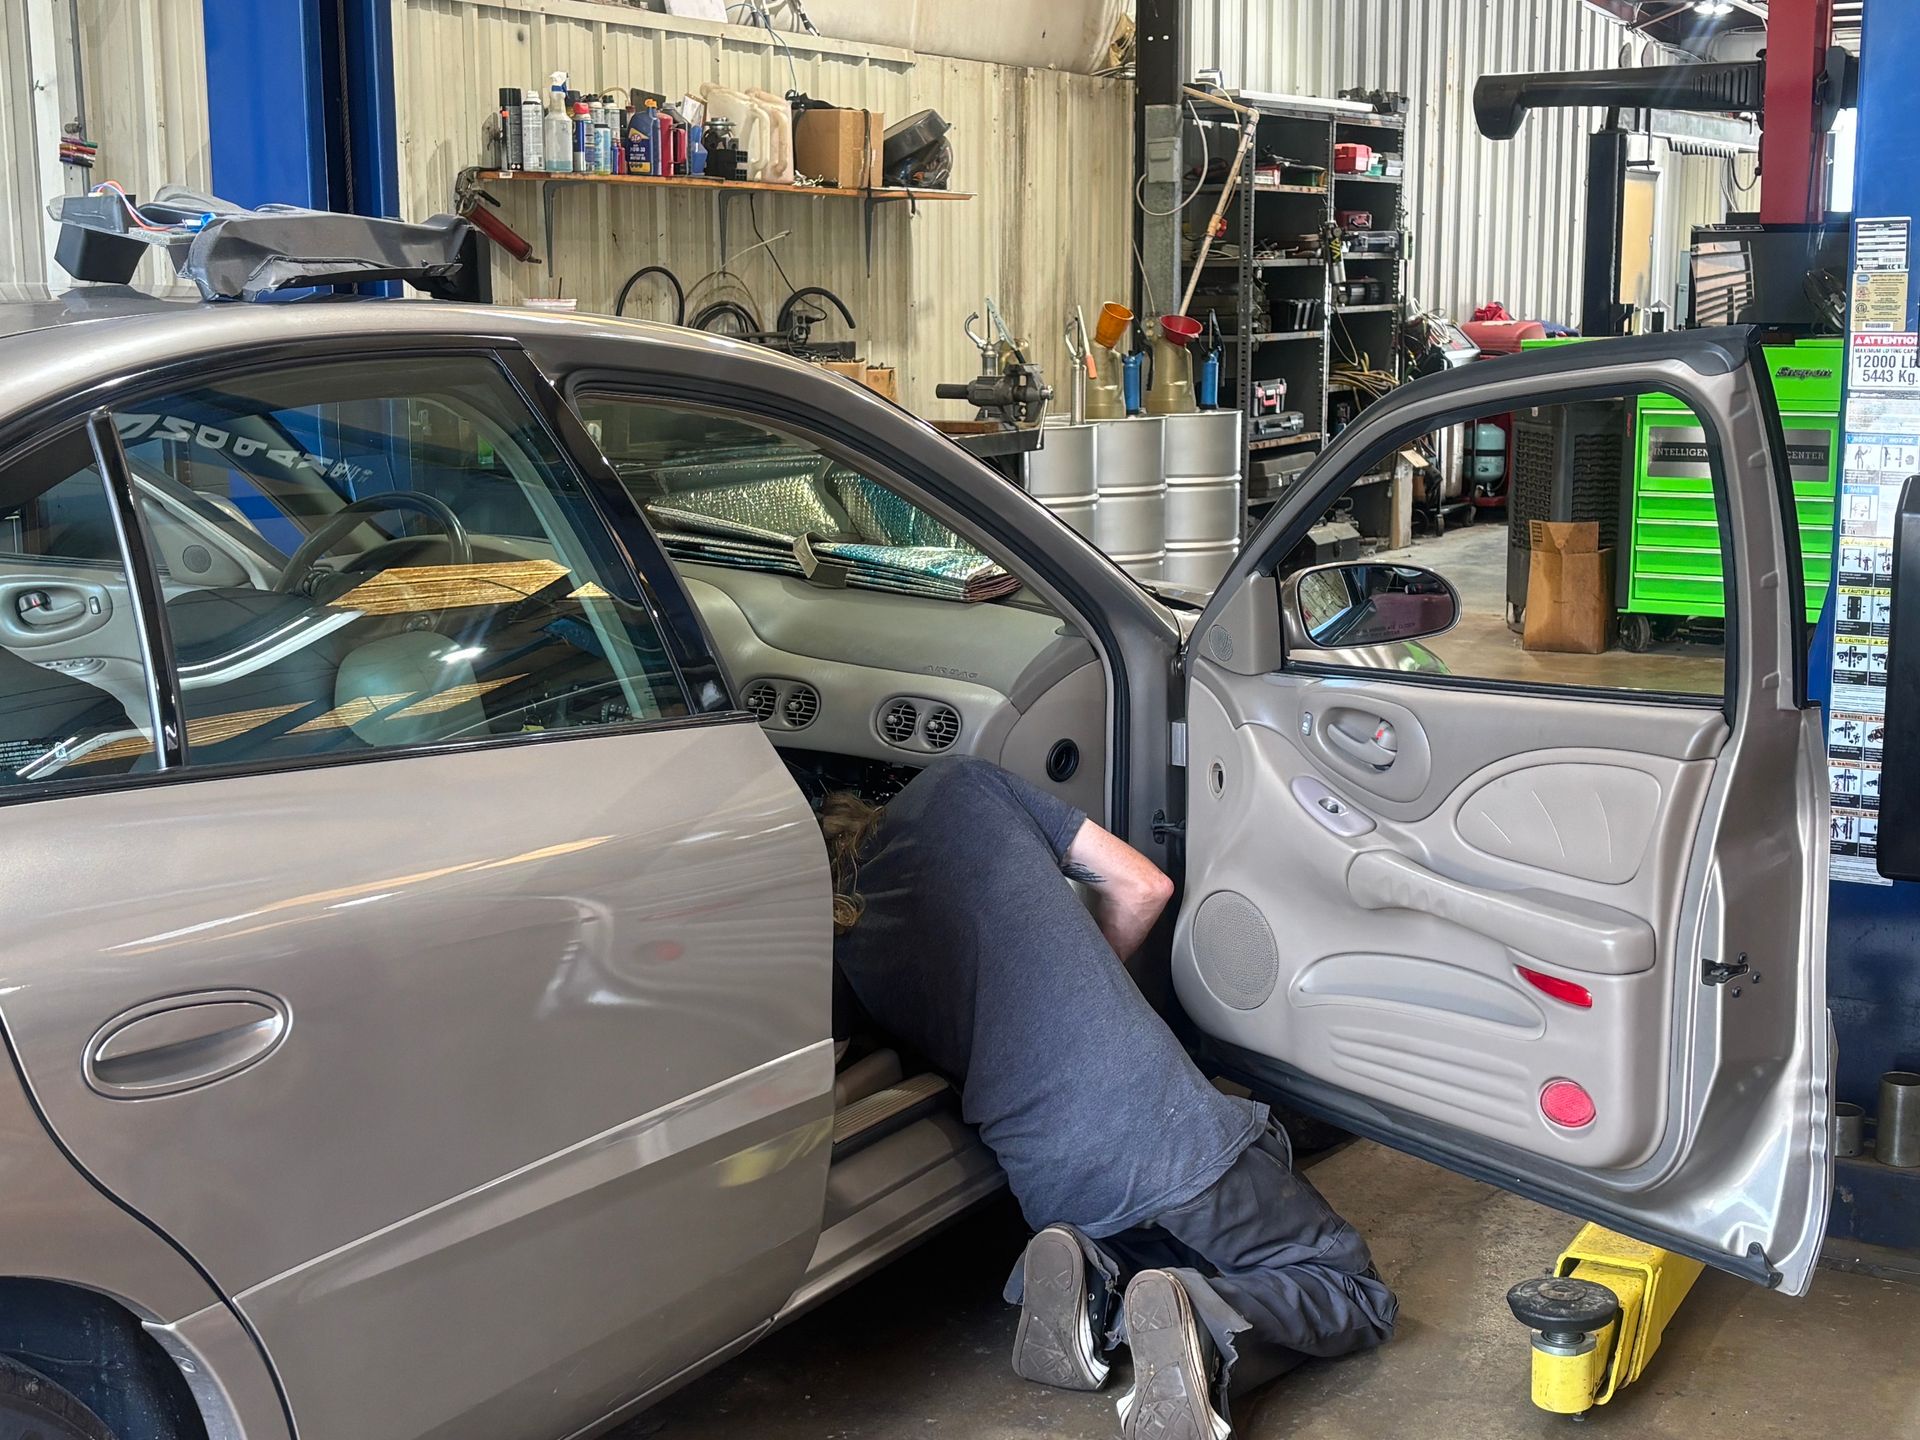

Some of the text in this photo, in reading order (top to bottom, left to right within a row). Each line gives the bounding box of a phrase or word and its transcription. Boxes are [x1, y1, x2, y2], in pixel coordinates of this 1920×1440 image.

[1856, 355, 1896, 368] 12000
[1863, 369, 1919, 385] 5443 Kg.
